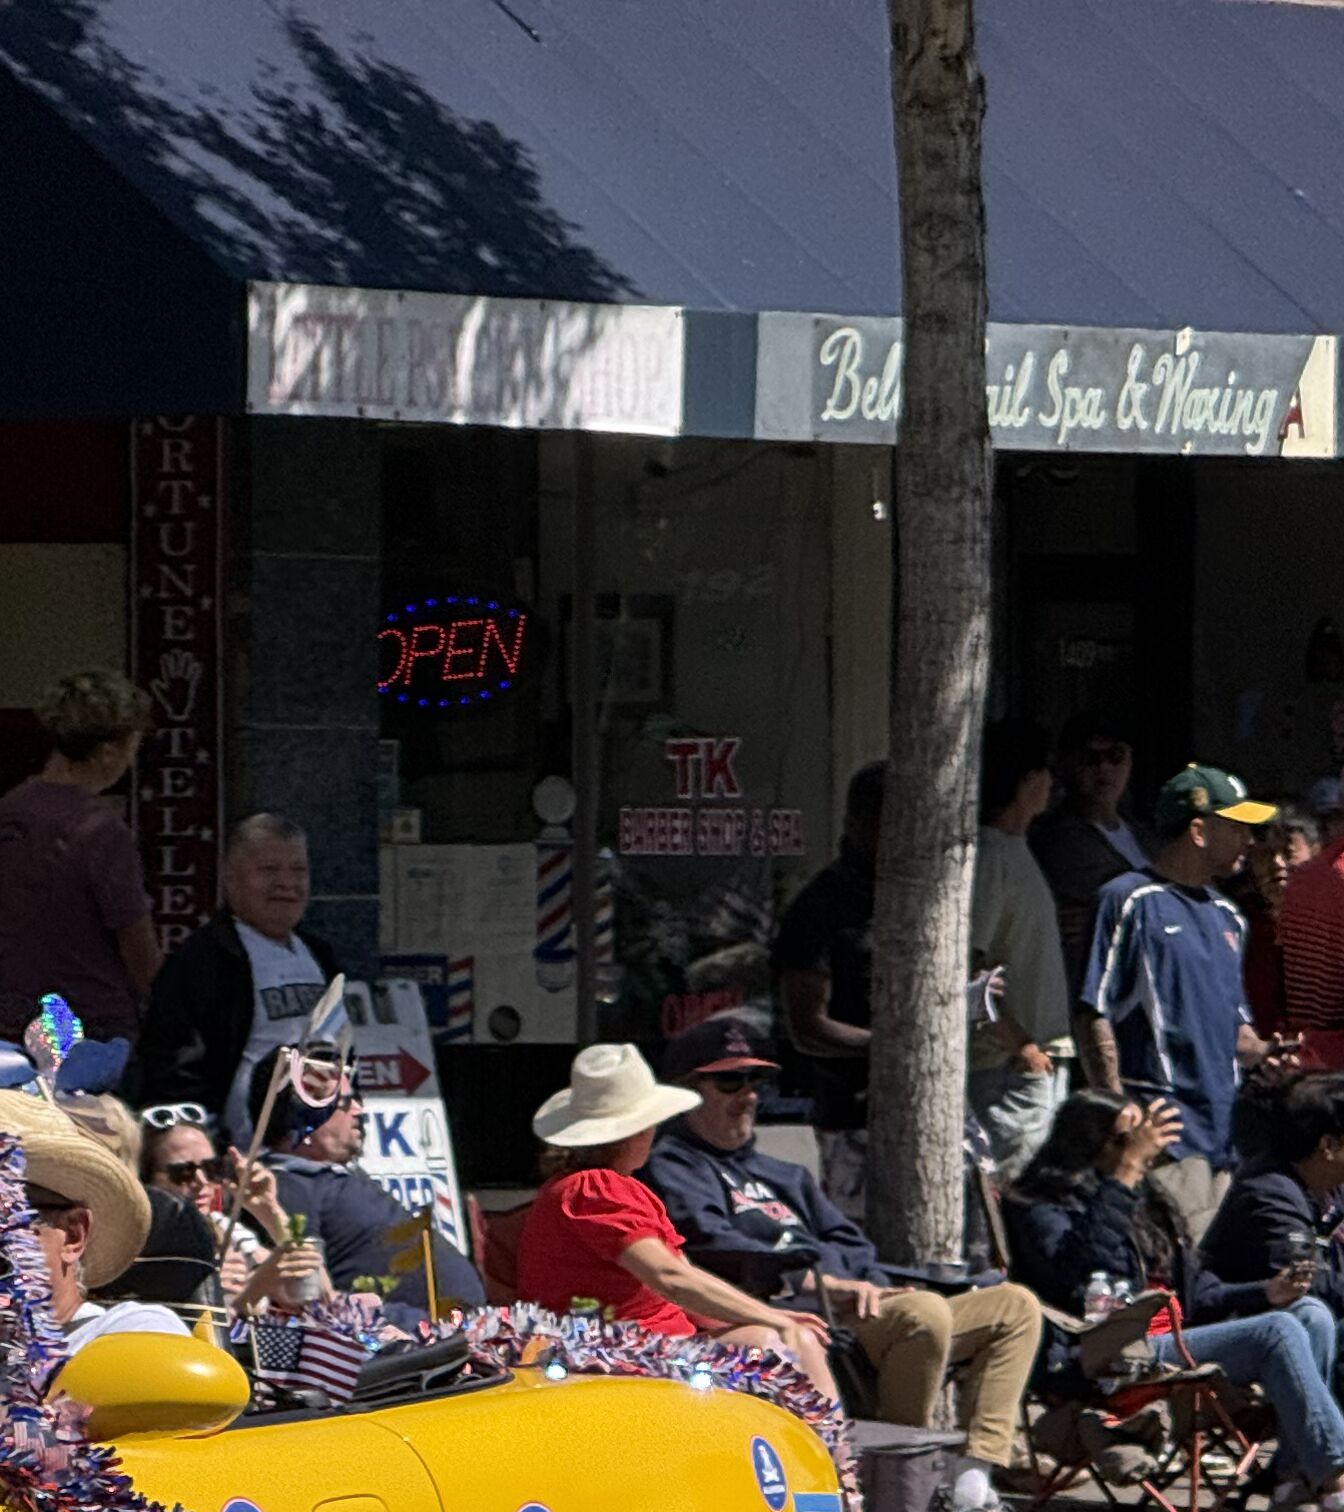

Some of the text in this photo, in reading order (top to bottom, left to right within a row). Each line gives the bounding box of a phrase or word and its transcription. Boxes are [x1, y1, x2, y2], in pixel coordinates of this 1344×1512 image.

[1038, 348, 1108, 445] Spa
[1116, 342, 1151, 433] &
[1152, 345, 1281, 456] Waxing
[376, 614, 529, 688] OPEN
[665, 737, 742, 799] TK
[618, 807, 695, 856] BARBER
[697, 808, 746, 856] SHOP
[768, 809, 807, 856] SPA
[359, 1059, 401, 1088] EN
